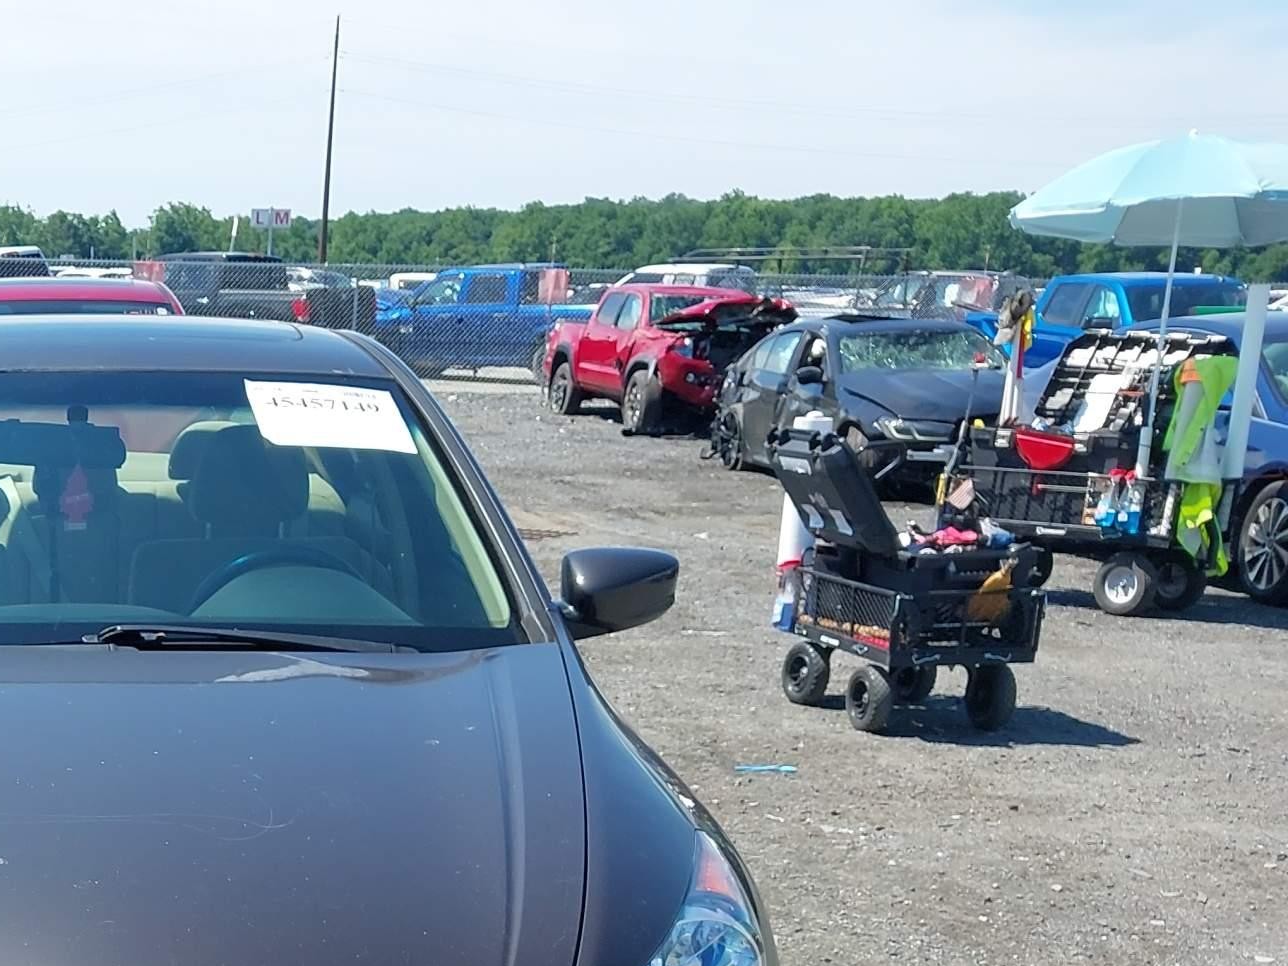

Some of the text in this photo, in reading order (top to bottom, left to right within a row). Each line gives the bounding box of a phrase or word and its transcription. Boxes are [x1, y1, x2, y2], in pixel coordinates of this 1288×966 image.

[255, 211, 264, 225] L
[275, 211, 289, 225] M
[266, 396, 380, 412] 45457149
